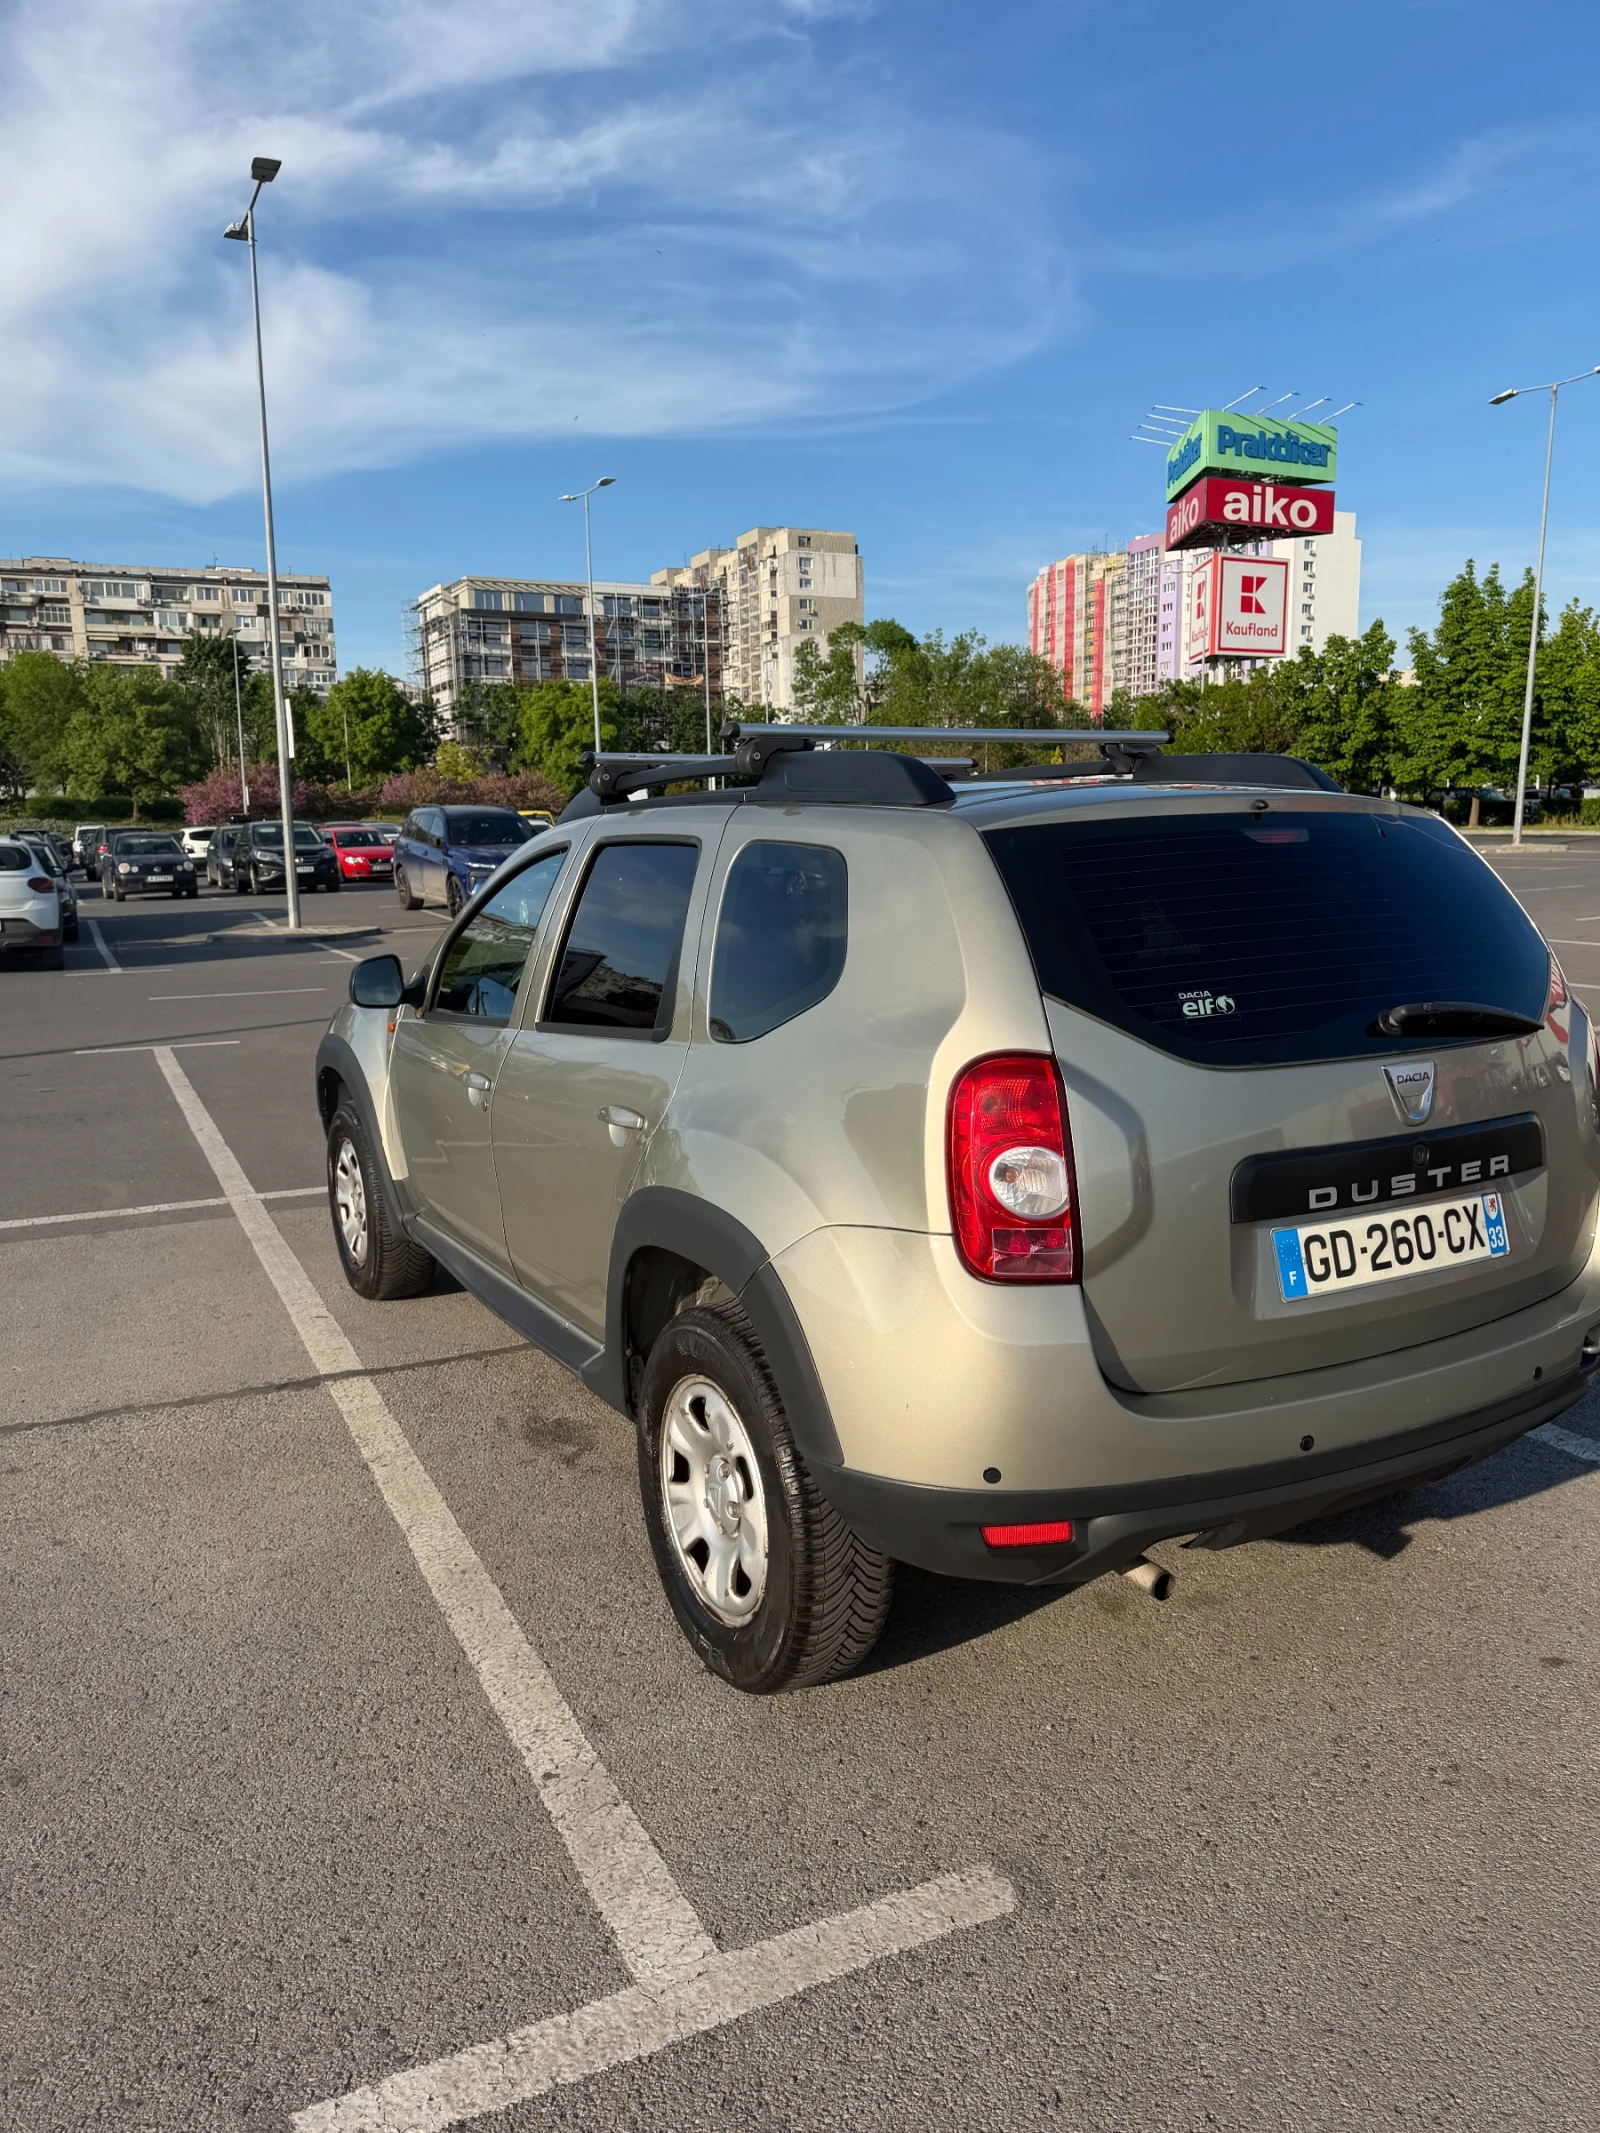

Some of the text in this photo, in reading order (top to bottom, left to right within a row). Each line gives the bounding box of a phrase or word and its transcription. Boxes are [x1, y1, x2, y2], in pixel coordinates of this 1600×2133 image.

[1217, 424, 1332, 468] Praktiker
[1170, 497, 1199, 544] aiko
[1222, 485, 1318, 528] aiko
[1240, 575, 1268, 614] K
[1226, 620, 1278, 638] Kaufland
[1178, 990, 1212, 1000] DACIA
[1182, 998, 1215, 1016] elf
[1396, 1070, 1431, 1085] DACIA
[1308, 1155, 1510, 1210] DUSTER
[1303, 1203, 1486, 1284] GD-260-CX
[1488, 1225, 1505, 1249] 33
[1289, 1271, 1297, 1286] F
